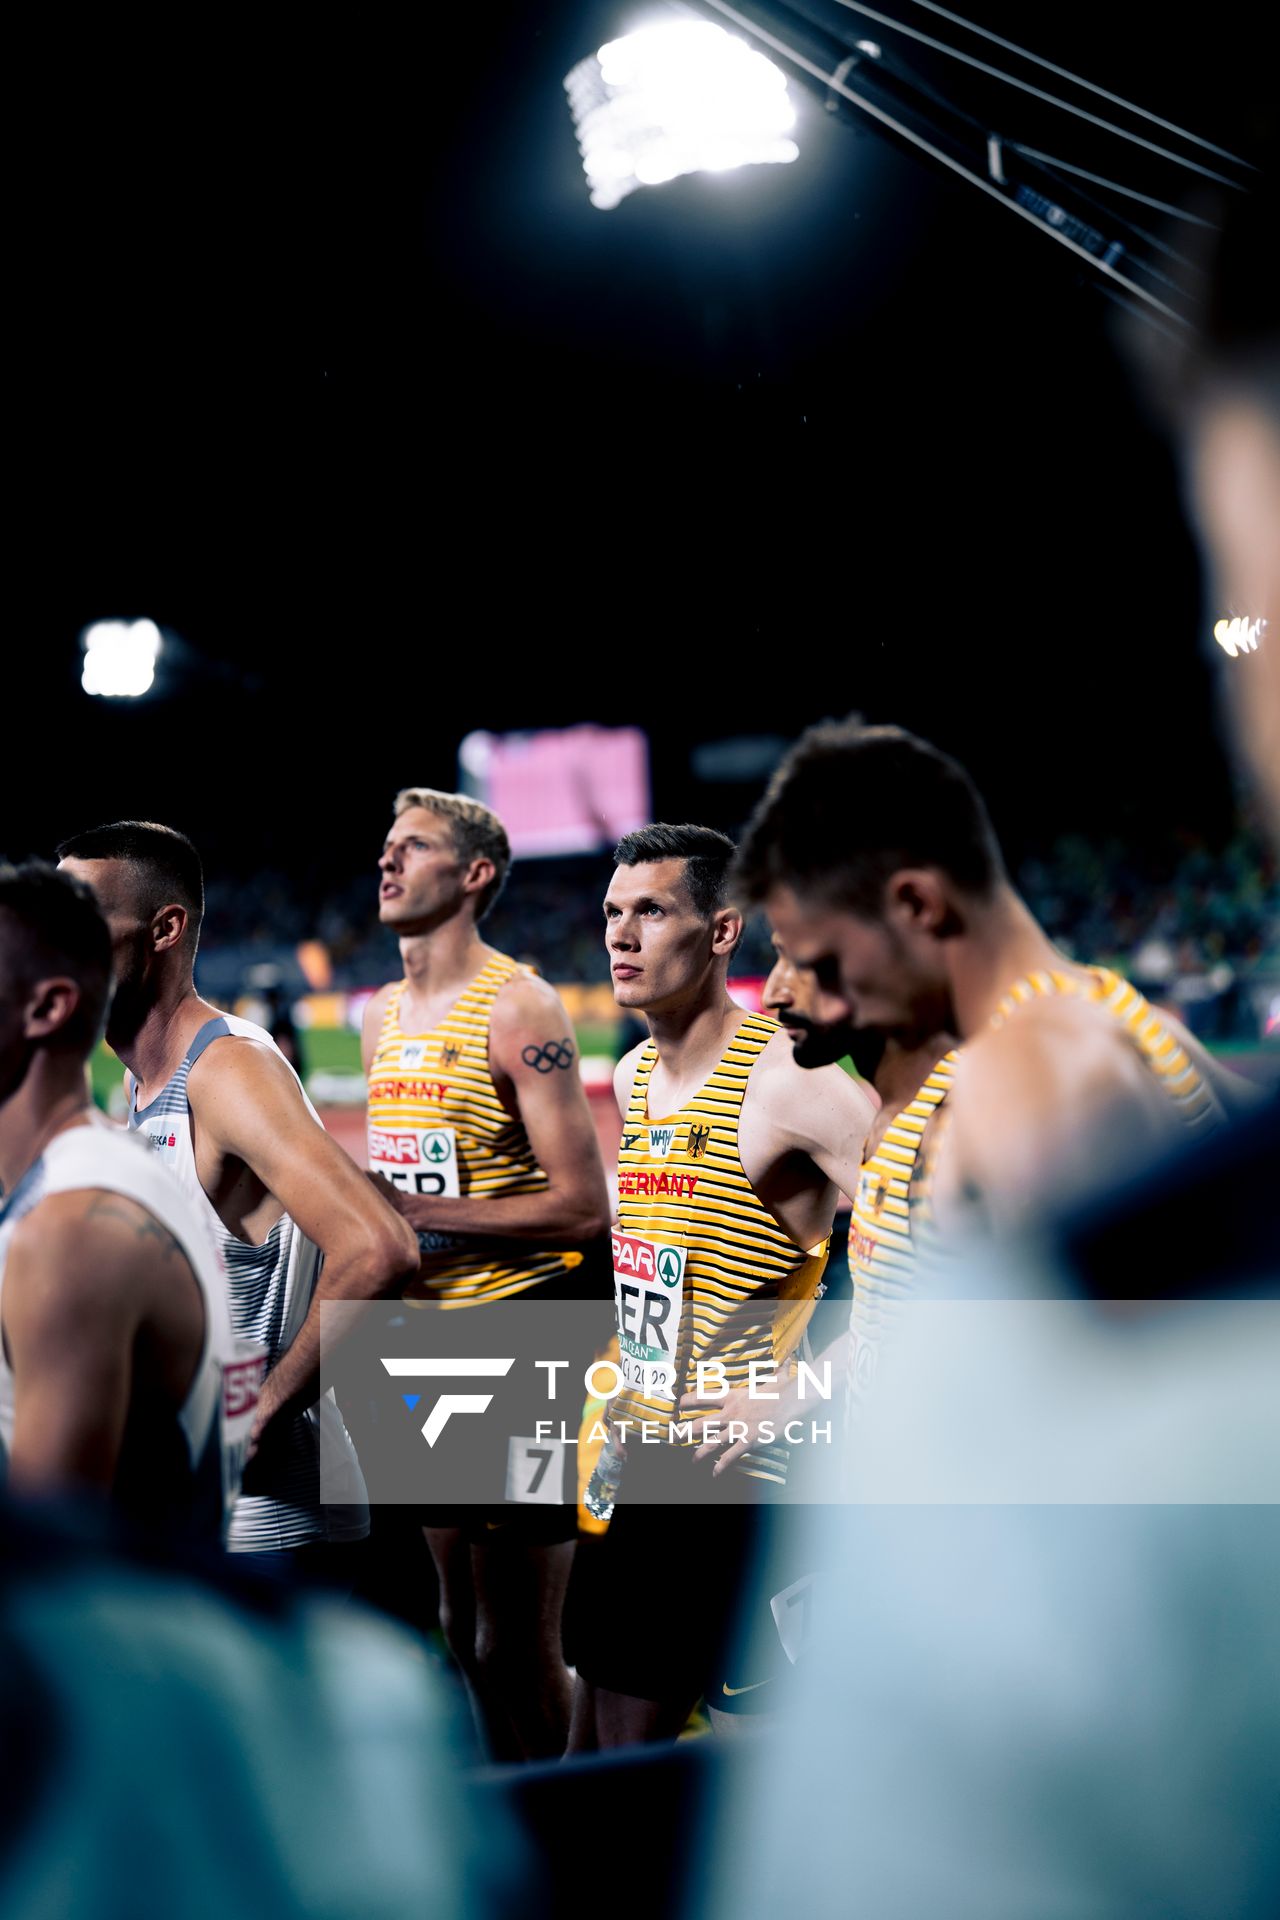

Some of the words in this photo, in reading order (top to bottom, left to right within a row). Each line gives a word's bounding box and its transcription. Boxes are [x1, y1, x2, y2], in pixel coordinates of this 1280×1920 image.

[619, 1172, 699, 1198] GERMANY
[611, 1238, 654, 1276] PAR
[614, 1283, 672, 1352] ER
[526, 1448, 553, 1494] 7
